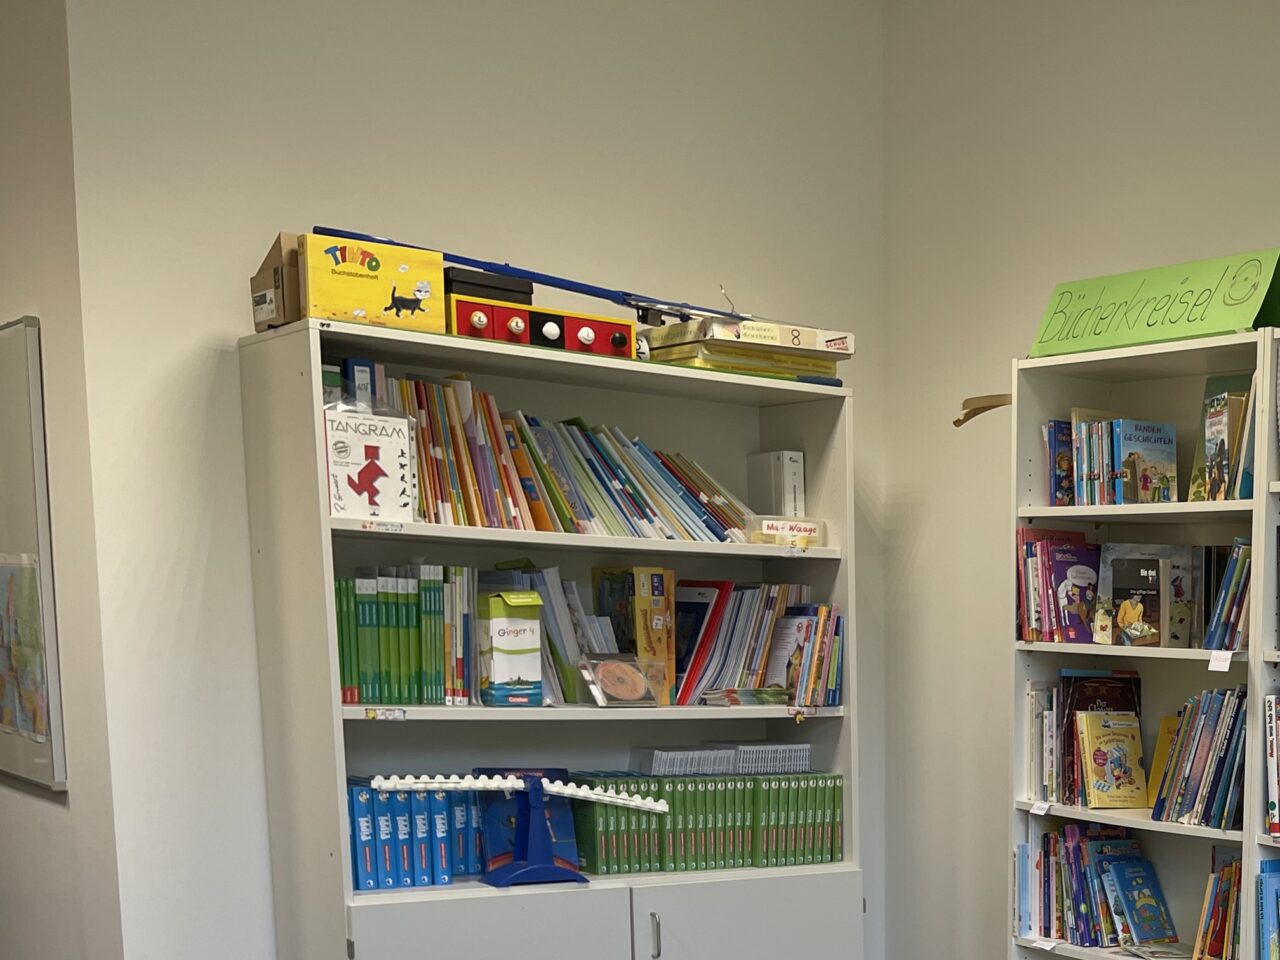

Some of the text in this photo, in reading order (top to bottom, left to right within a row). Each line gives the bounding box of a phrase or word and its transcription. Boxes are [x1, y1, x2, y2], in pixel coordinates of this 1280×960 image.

[324, 245, 381, 272] TINTO
[1038, 264, 1230, 346] Bücherkreisel
[791, 328, 801, 347] 8
[825, 339, 848, 349] SCHUBI
[328, 419, 406, 439] TANGRAM
[498, 627, 527, 638] Ginger
